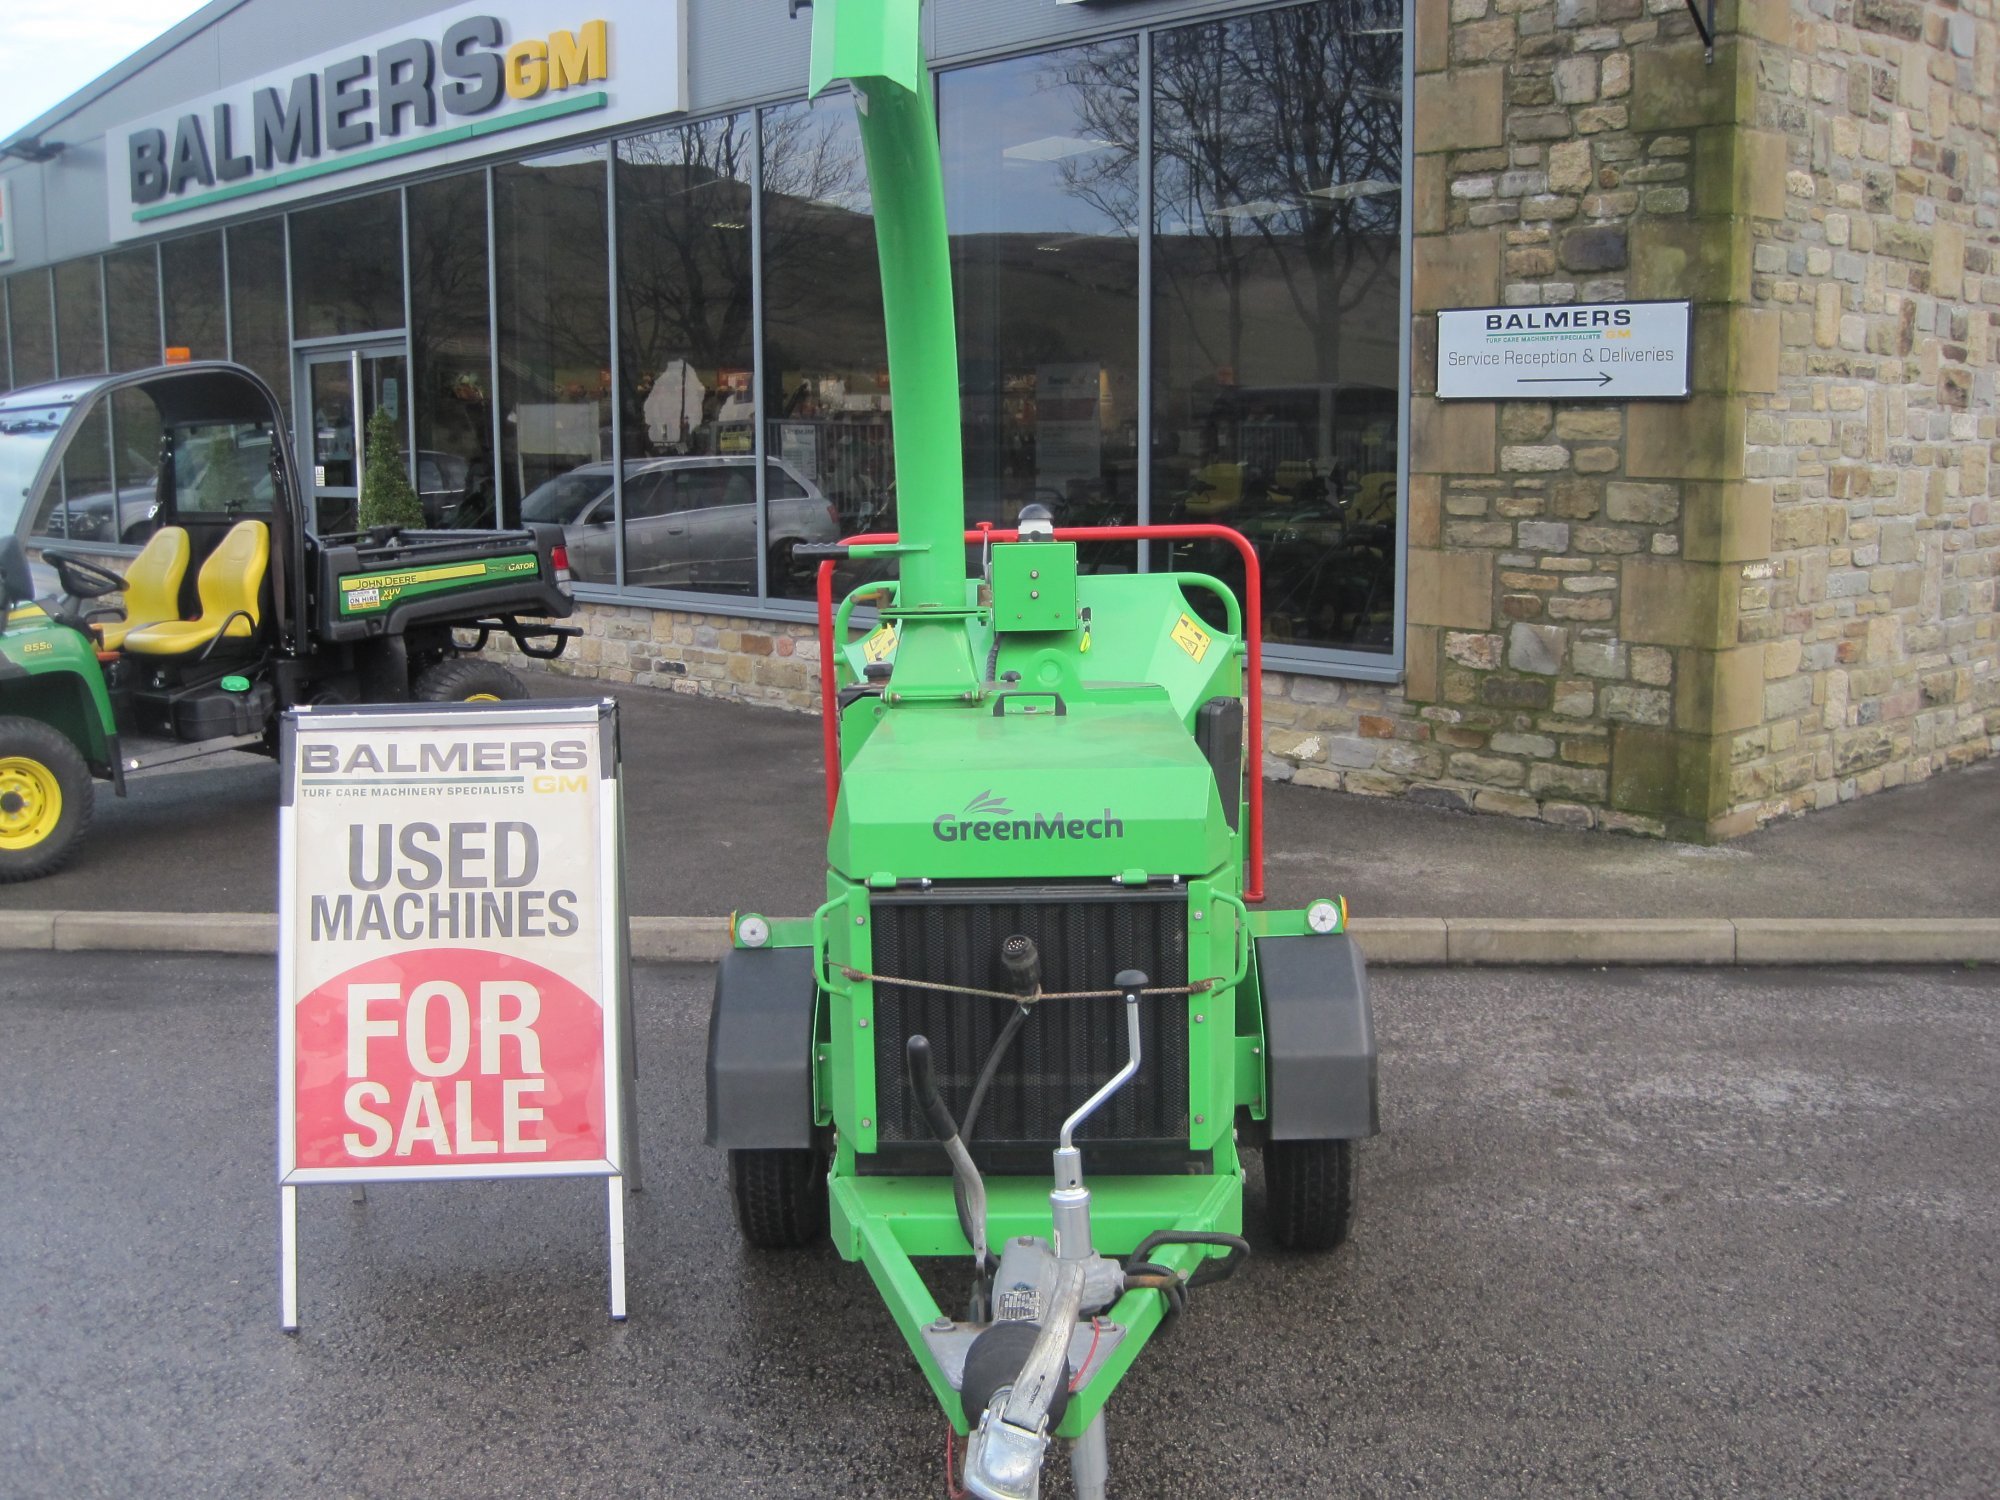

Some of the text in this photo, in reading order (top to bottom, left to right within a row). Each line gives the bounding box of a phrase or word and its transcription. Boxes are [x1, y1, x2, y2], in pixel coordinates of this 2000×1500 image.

[130, 15, 608, 203] BALMERS GM
[1486, 309, 1631, 330] BALMERS
[1605, 330, 1631, 339] GM
[1448, 346, 1674, 368] Service Reception & Deliveries
[508, 562, 535, 572] GATOR
[356, 575, 417, 589] JOHN DEERE
[383, 588, 401, 597] XUV
[362, 595, 378, 603] HIRE
[302, 740, 588, 774] BALMERS
[302, 785, 525, 798] TURF CARE MACHINERY SPECIALISTS
[532, 775, 588, 794] GM
[933, 807, 1124, 842] GreenMech
[349, 821, 540, 891] USED
[311, 889, 580, 942] MACHINES
[347, 980, 545, 1078] FOR
[343, 1078, 547, 1158] SALE
